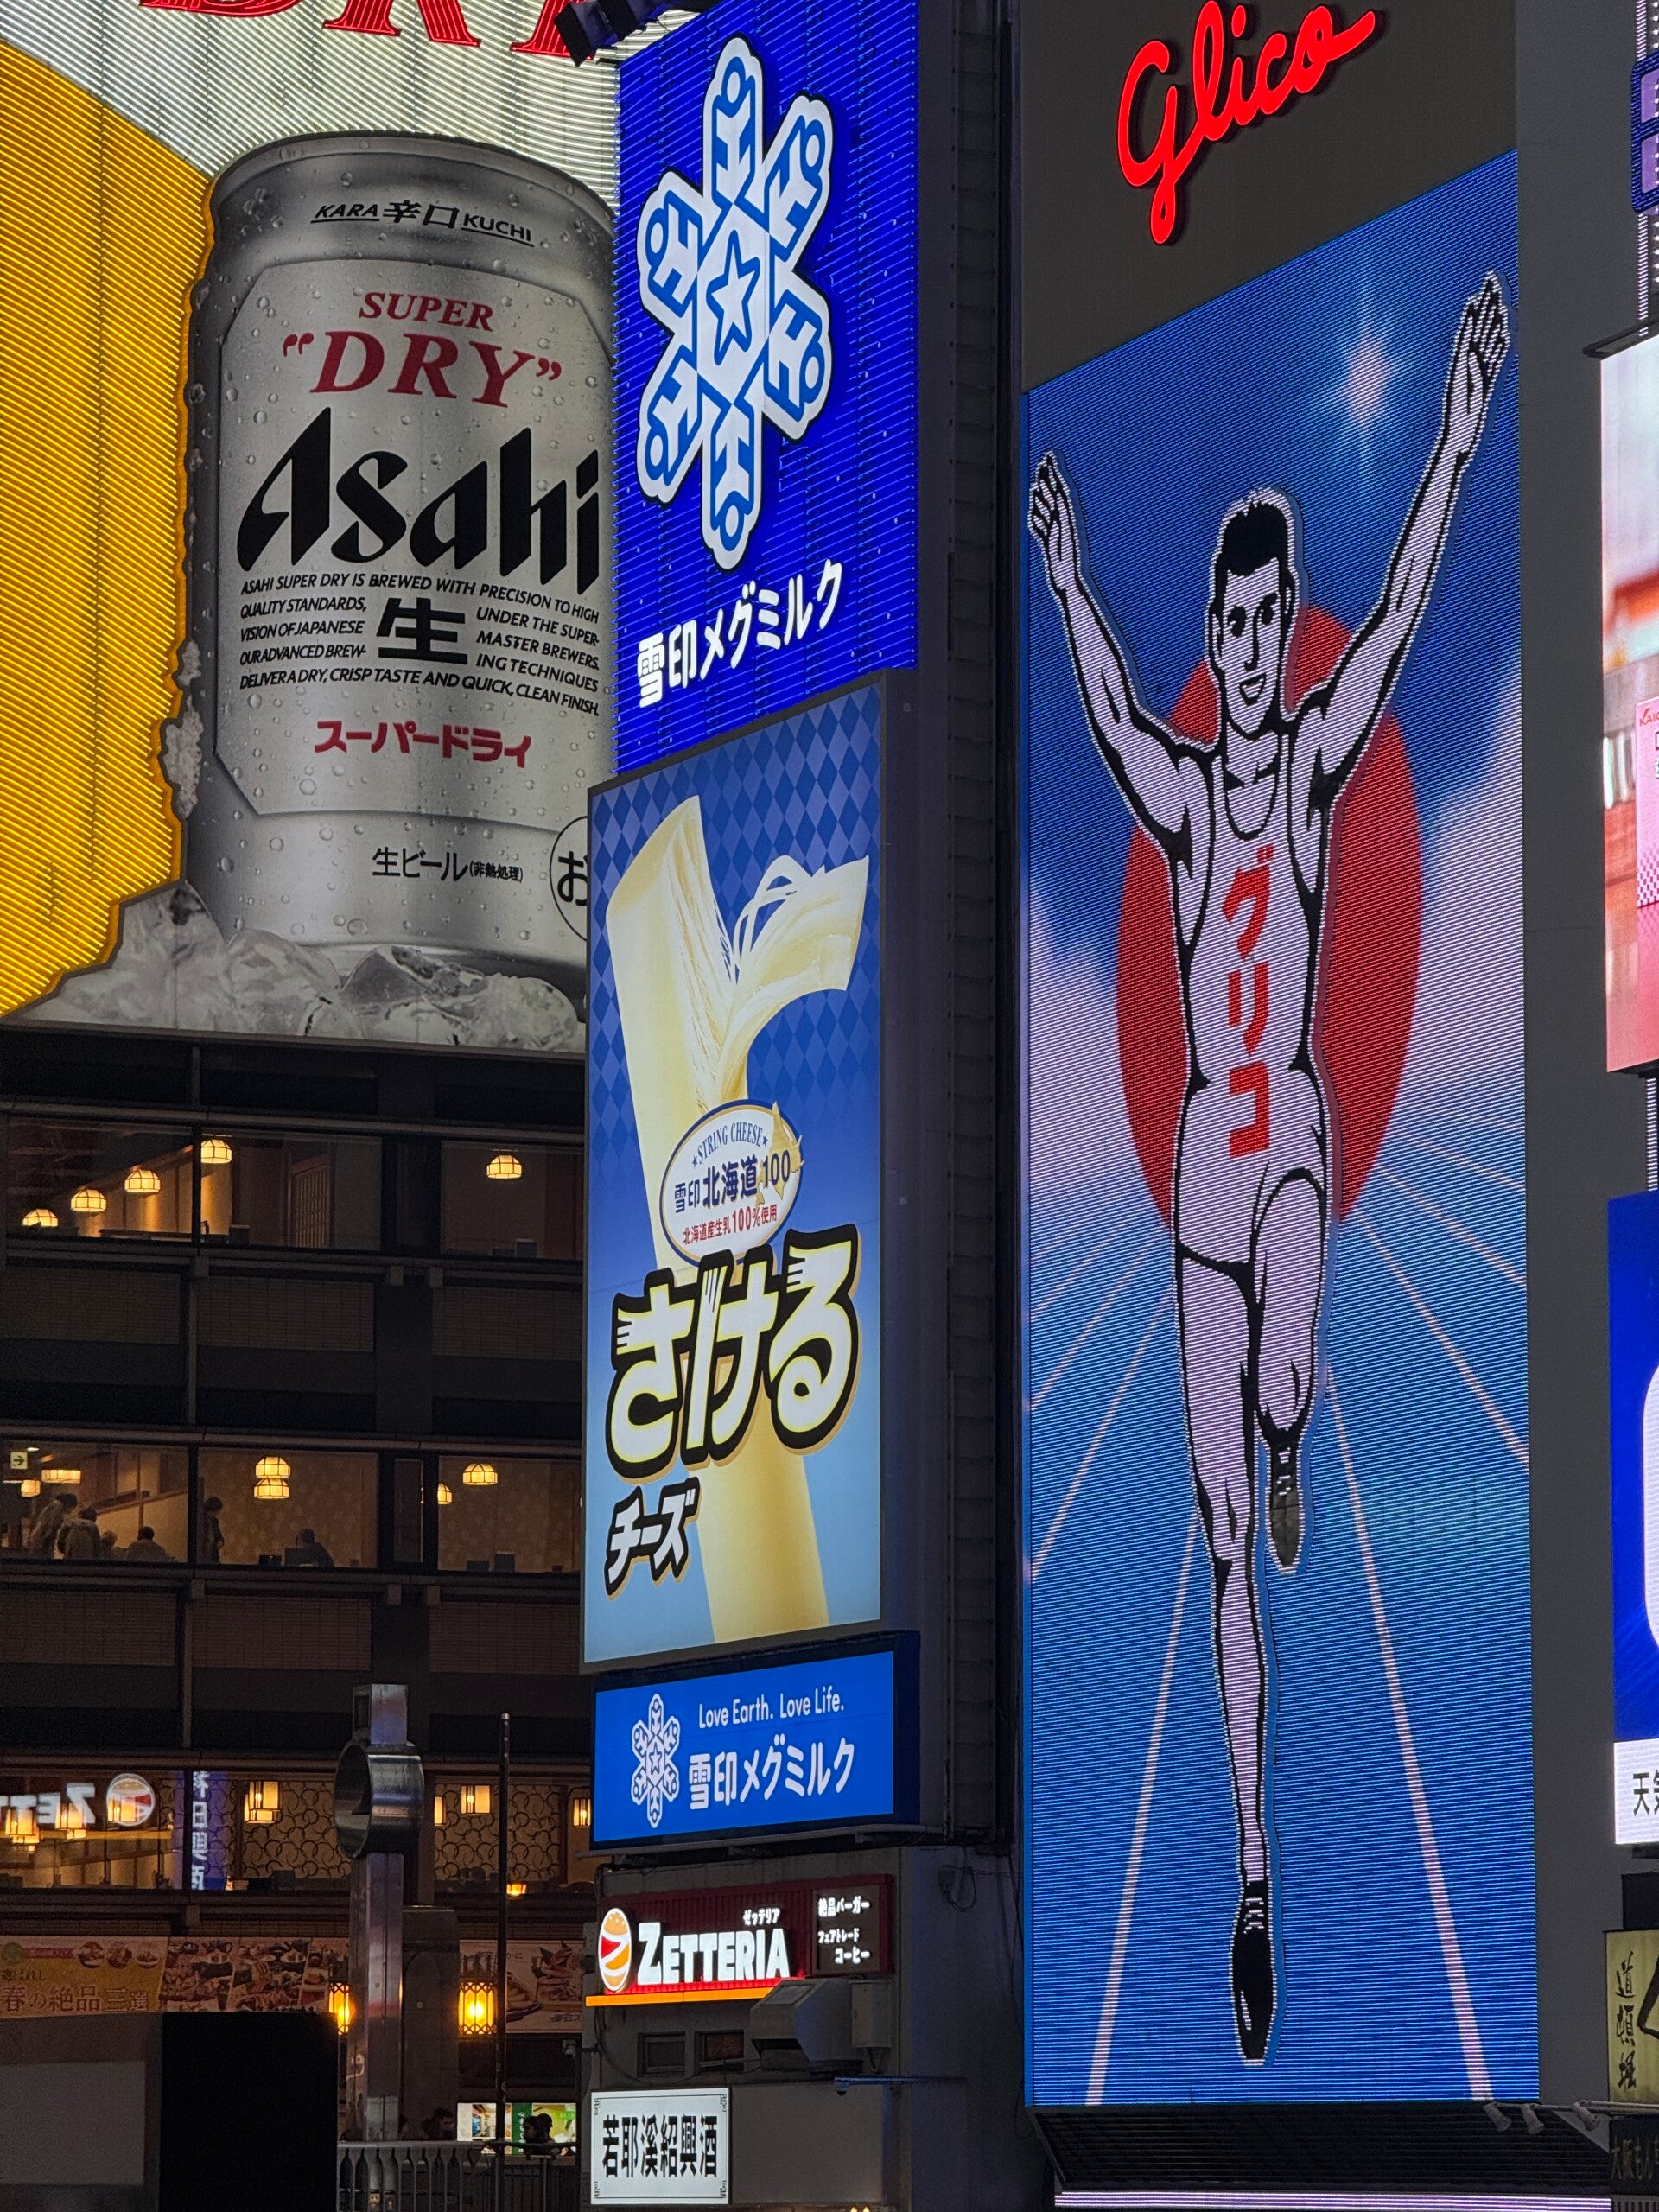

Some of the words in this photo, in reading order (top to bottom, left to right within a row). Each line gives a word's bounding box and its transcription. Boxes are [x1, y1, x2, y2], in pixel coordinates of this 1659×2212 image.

[1117, 0, 1376, 245] Glico
[314, 203, 378, 220] KARA
[382, 200, 460, 230] 辛口
[461, 213, 532, 242] KUCHI
[358, 290, 493, 332] SUPER
[238, 407, 599, 594] Asahi
[240, 576, 274, 595] ASAHI
[276, 574, 317, 589] SUPER
[320, 573, 351, 587] DRY
[352, 573, 365, 587] IS
[369, 574, 432, 589] BREWED
[436, 578, 476, 595] WITH
[479, 583, 551, 609] PRECISION
[554, 599, 570, 614] TO
[572, 604, 600, 624] HIGH
[240, 599, 287, 619] QUALITY
[286, 597, 367, 613] STANDARDS,
[240, 624, 278, 642] VISION
[278, 622, 295, 636] OF
[294, 620, 365, 636] JAPANESE
[376, 597, 468, 665] 生
[476, 607, 530, 628] UNDER
[533, 616, 559, 635] THE
[560, 624, 600, 646] SUPER-
[636, 557, 844, 709] 雪印メグミルク
[240, 649, 260, 665] OUR
[260, 645, 326, 662] ADVANCED
[325, 644, 366, 658] BREW-
[476, 630, 540, 653] MASTER
[542, 642, 600, 671] BREWERS.
[476, 653, 508, 671] ING
[510, 658, 600, 693] TECHNIQUES
[240, 672, 287, 690] DELIVER
[287, 670, 296, 684] A
[298, 668, 328, 683] DRY,
[330, 668, 373, 682] CRISP
[373, 668, 422, 684] TASTE
[422, 671, 460, 688] AND
[462, 675, 514, 696] QUICK,
[516, 683, 560, 705] CLEAN
[561, 694, 600, 716] FINISH.
[314, 720, 532, 768] スーパードライ
[1223, 844, 1274, 1159] グリコ
[697, 1125, 728, 1165] STRING
[730, 1122, 763, 1147] CHEESE
[607, 1229, 856, 1472] さける
[607, 1481, 698, 1592] チーズ
[699, 1703, 728, 1729] Love
[733, 1694, 773, 1725] Earth.
[779, 1693, 810, 1719] Love
[815, 1685, 844, 1714] Life.
[689, 1733, 855, 1810] 雪印メグミルク
[742, 1908, 780, 1927] ゼッテリア
[637, 1922, 790, 1986] ZETTERIA
[834, 1946, 870, 1965] コーヒー
